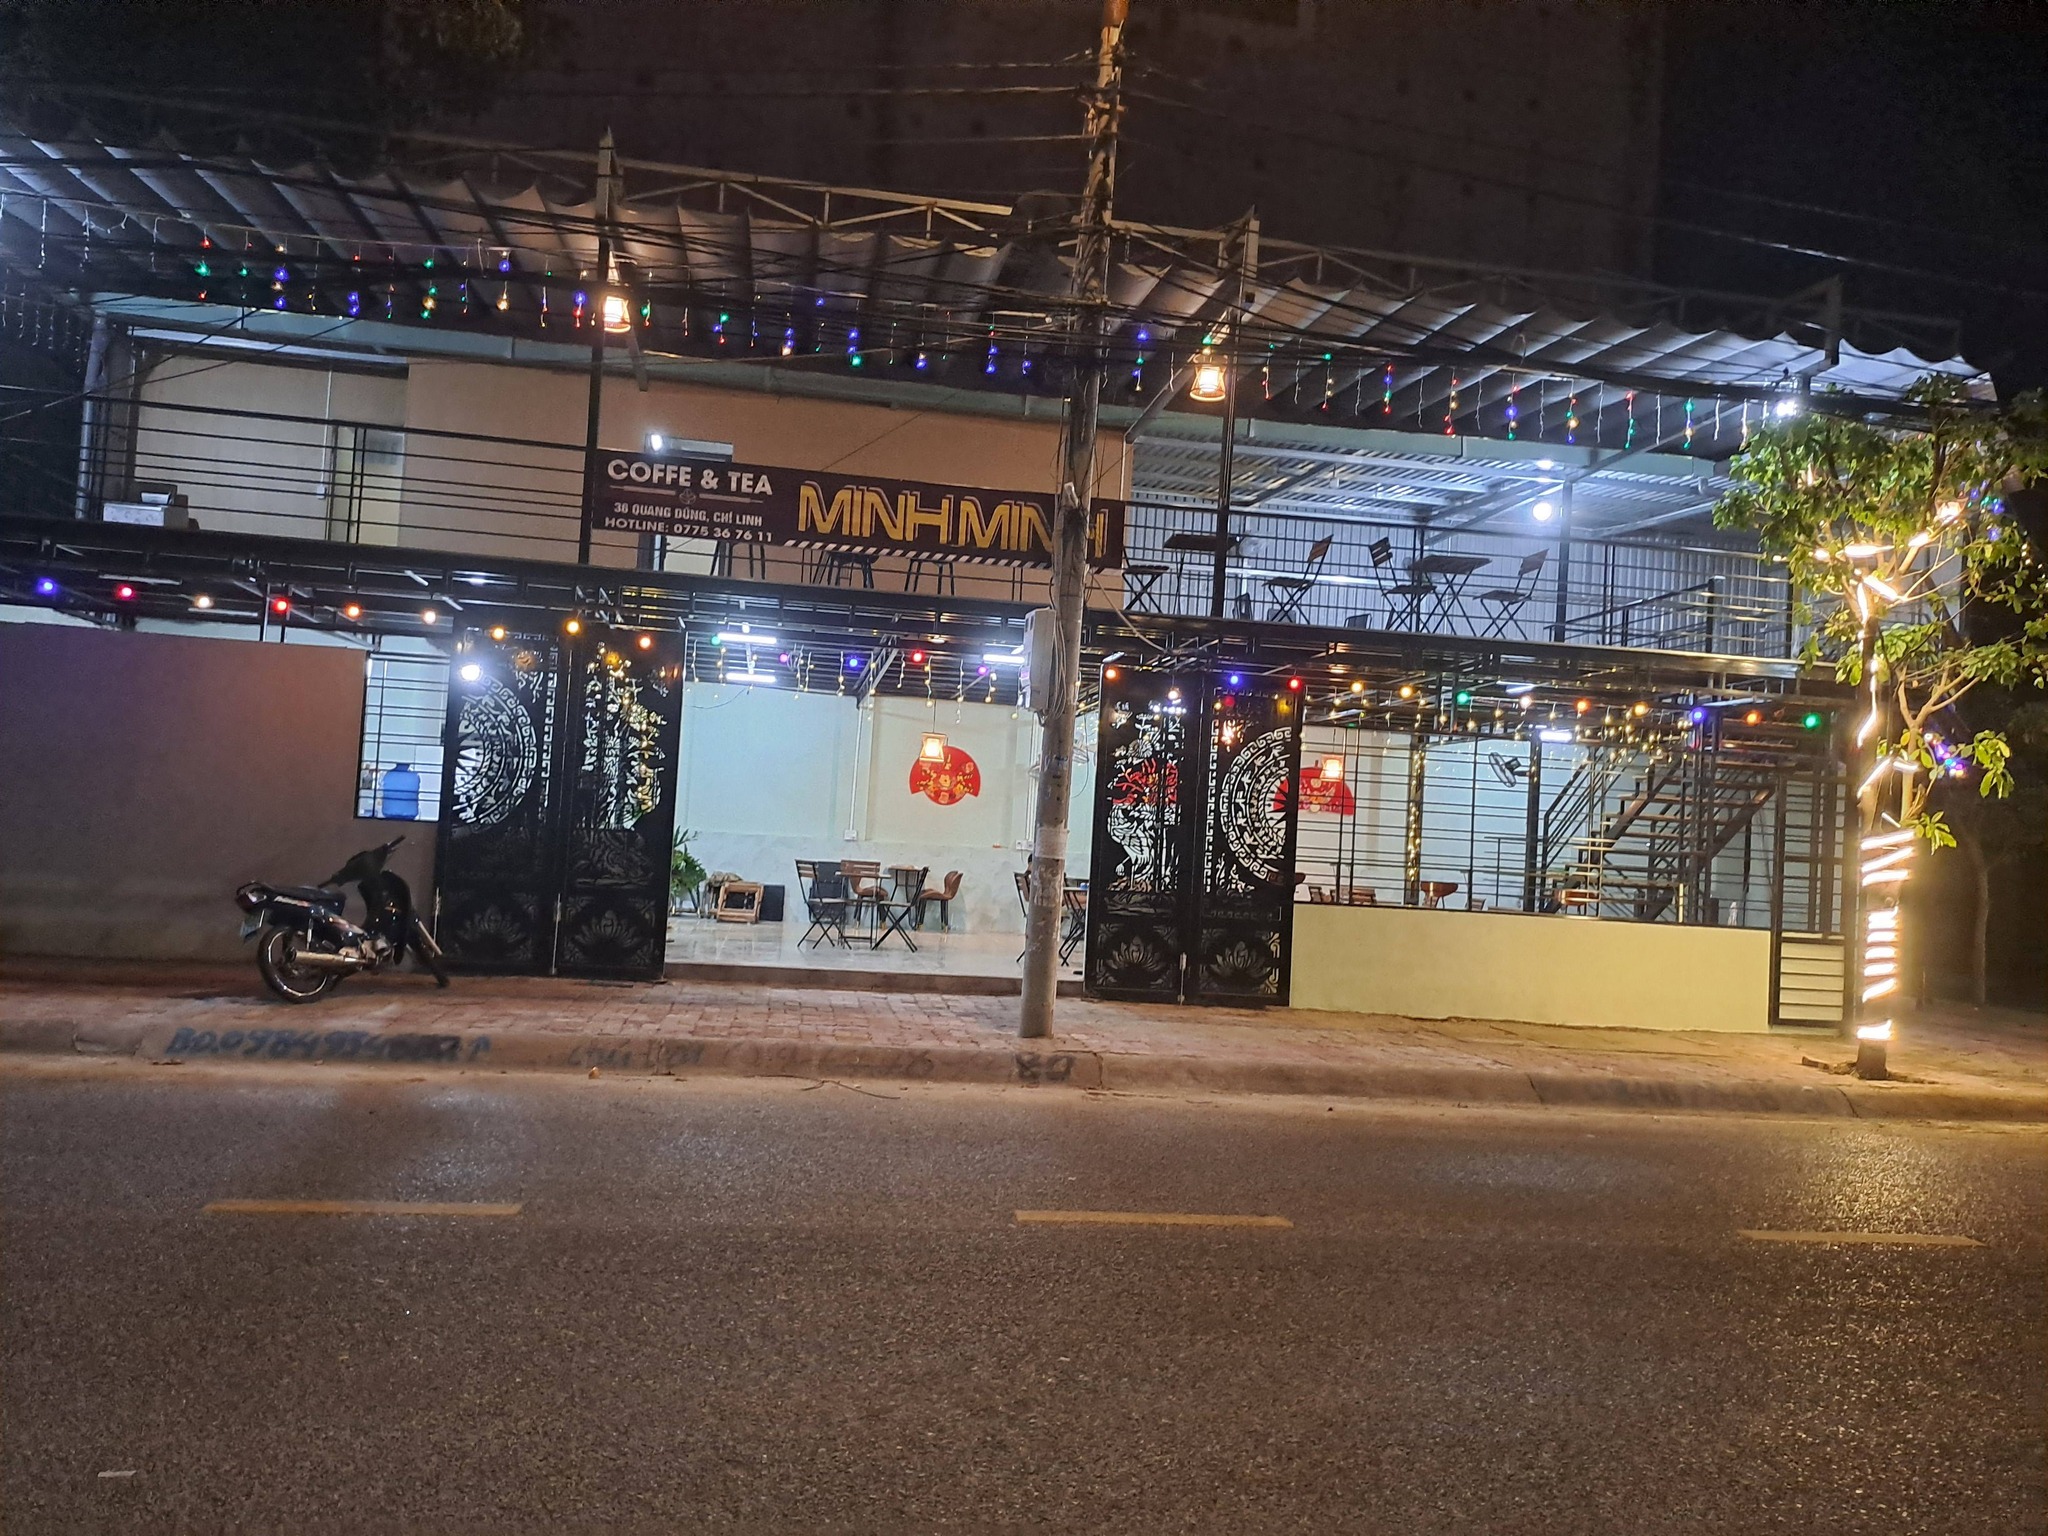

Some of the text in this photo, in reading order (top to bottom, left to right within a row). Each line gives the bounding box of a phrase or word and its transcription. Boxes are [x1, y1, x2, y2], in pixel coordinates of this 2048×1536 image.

[608, 459, 773, 495] COFFE & TEA
[632, 503, 671, 518] QUANG
[713, 510, 733, 524] CHÍ
[736, 513, 763, 527] LINH
[797, 480, 954, 545] MINH
[604, 516, 773, 542] HOTLINE: 0775 36 76 11
